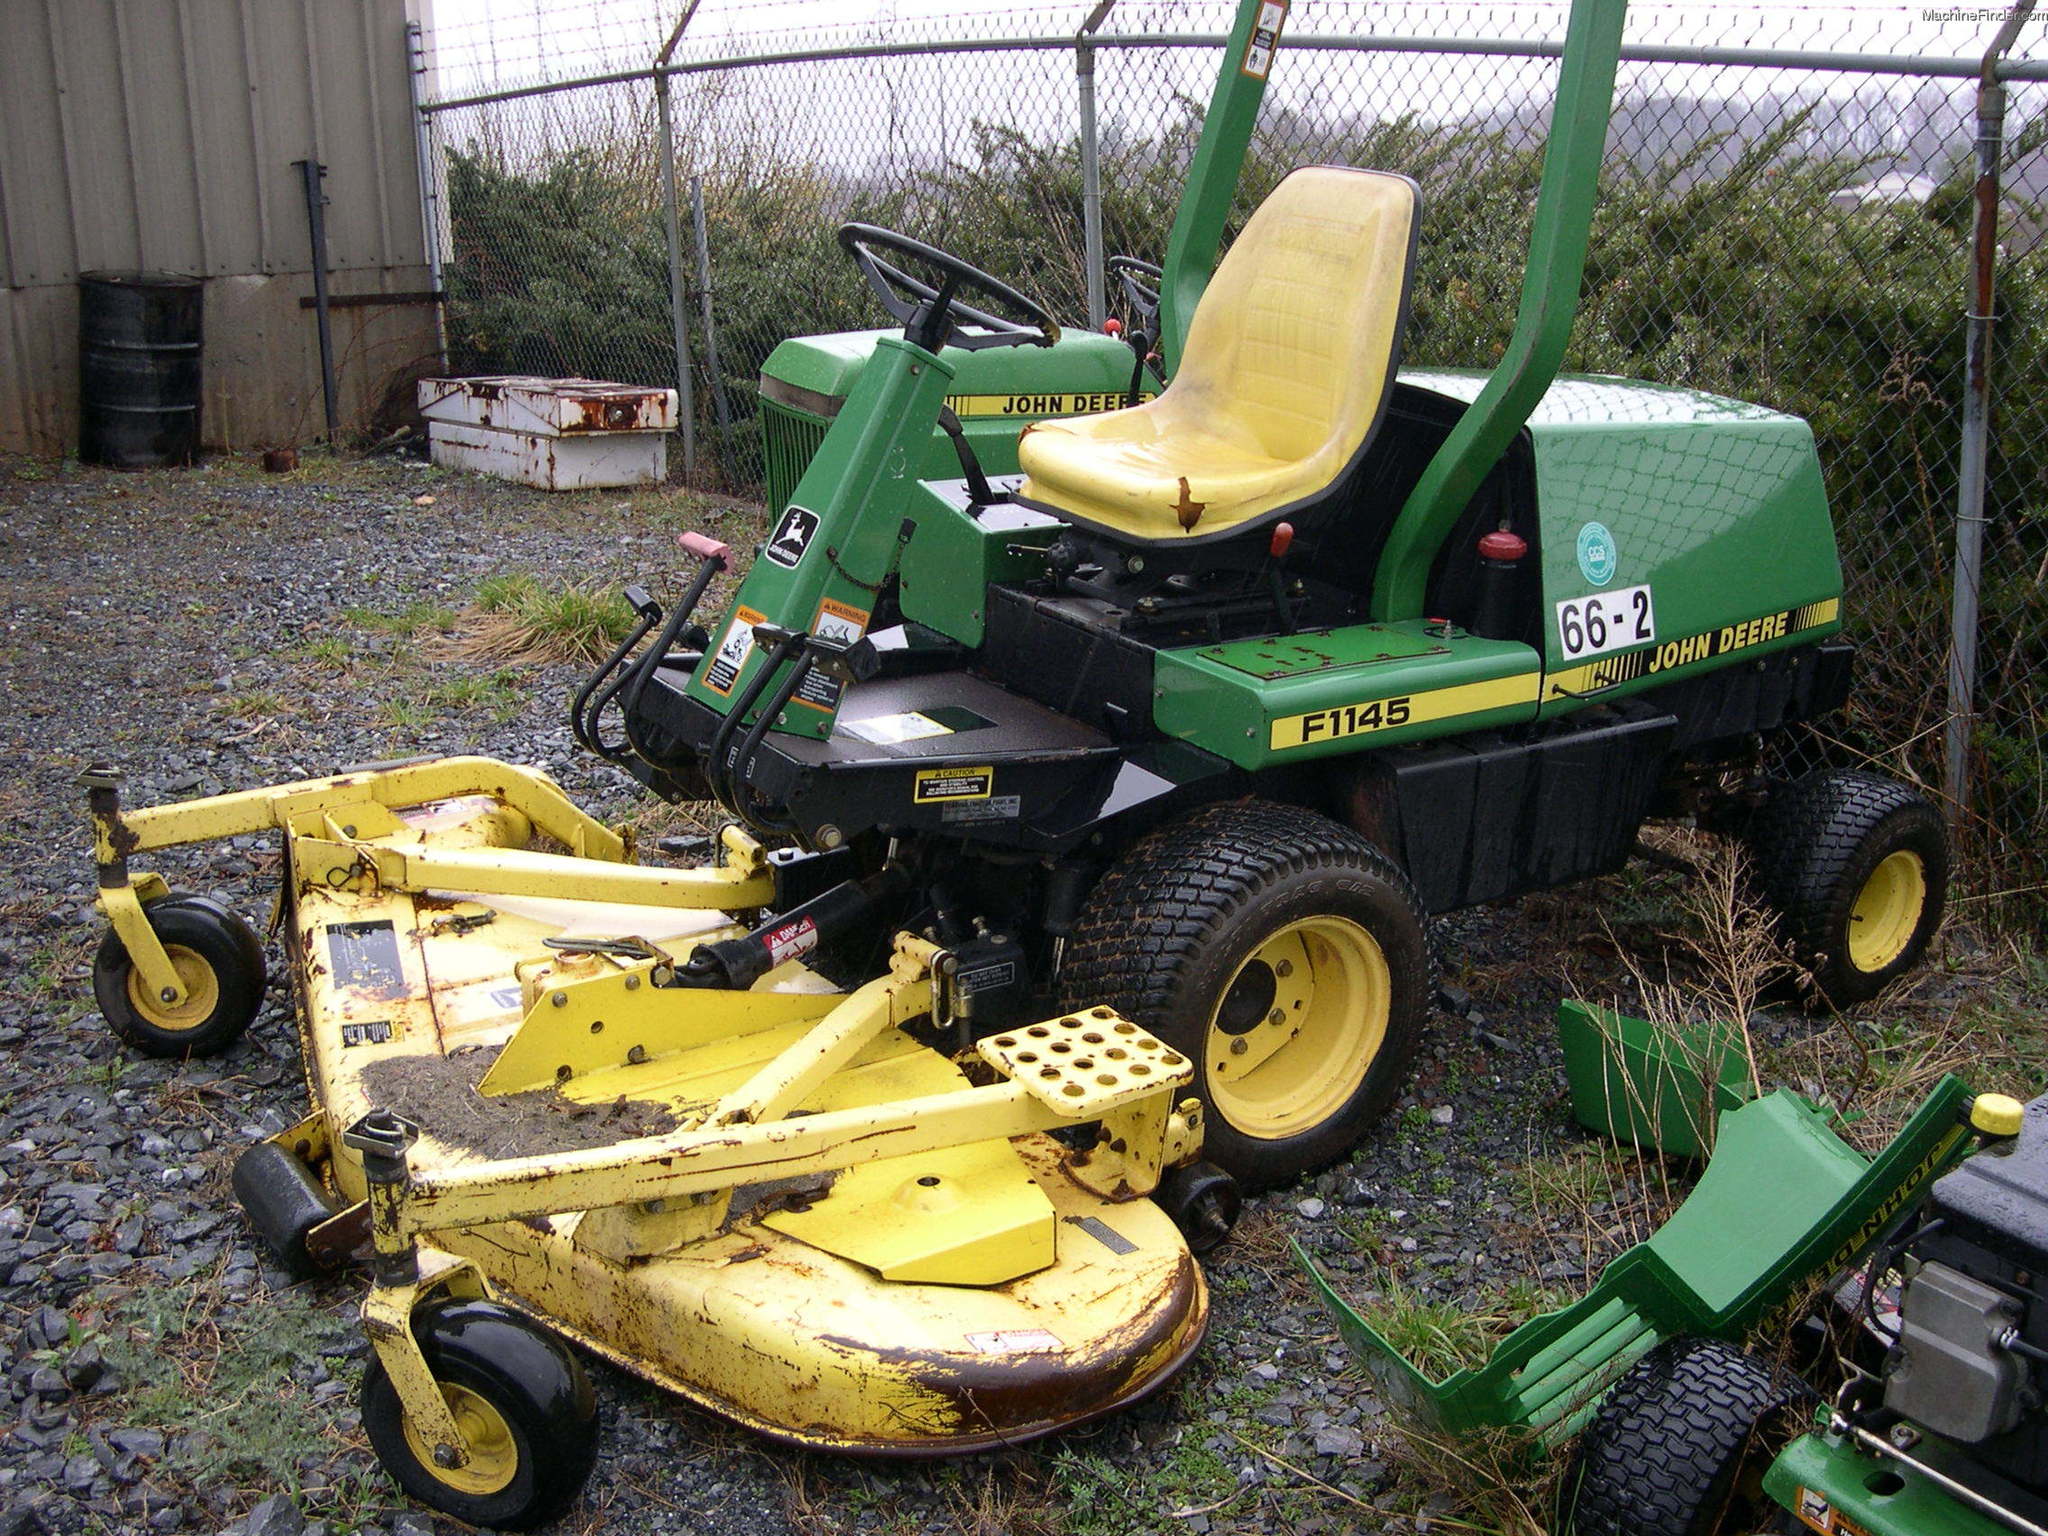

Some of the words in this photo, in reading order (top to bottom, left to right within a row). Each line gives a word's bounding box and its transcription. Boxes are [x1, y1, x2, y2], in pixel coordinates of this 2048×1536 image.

[1003, 396, 1062, 414] JOHN
[831, 604, 867, 621] WARNING
[1649, 632, 1712, 673] JOHN
[1718, 611, 1790, 654] DEERE
[1302, 698, 1410, 742] F1145
[942, 769, 976, 778] CAUTION
[1861, 1142, 1942, 1240] JOHN
